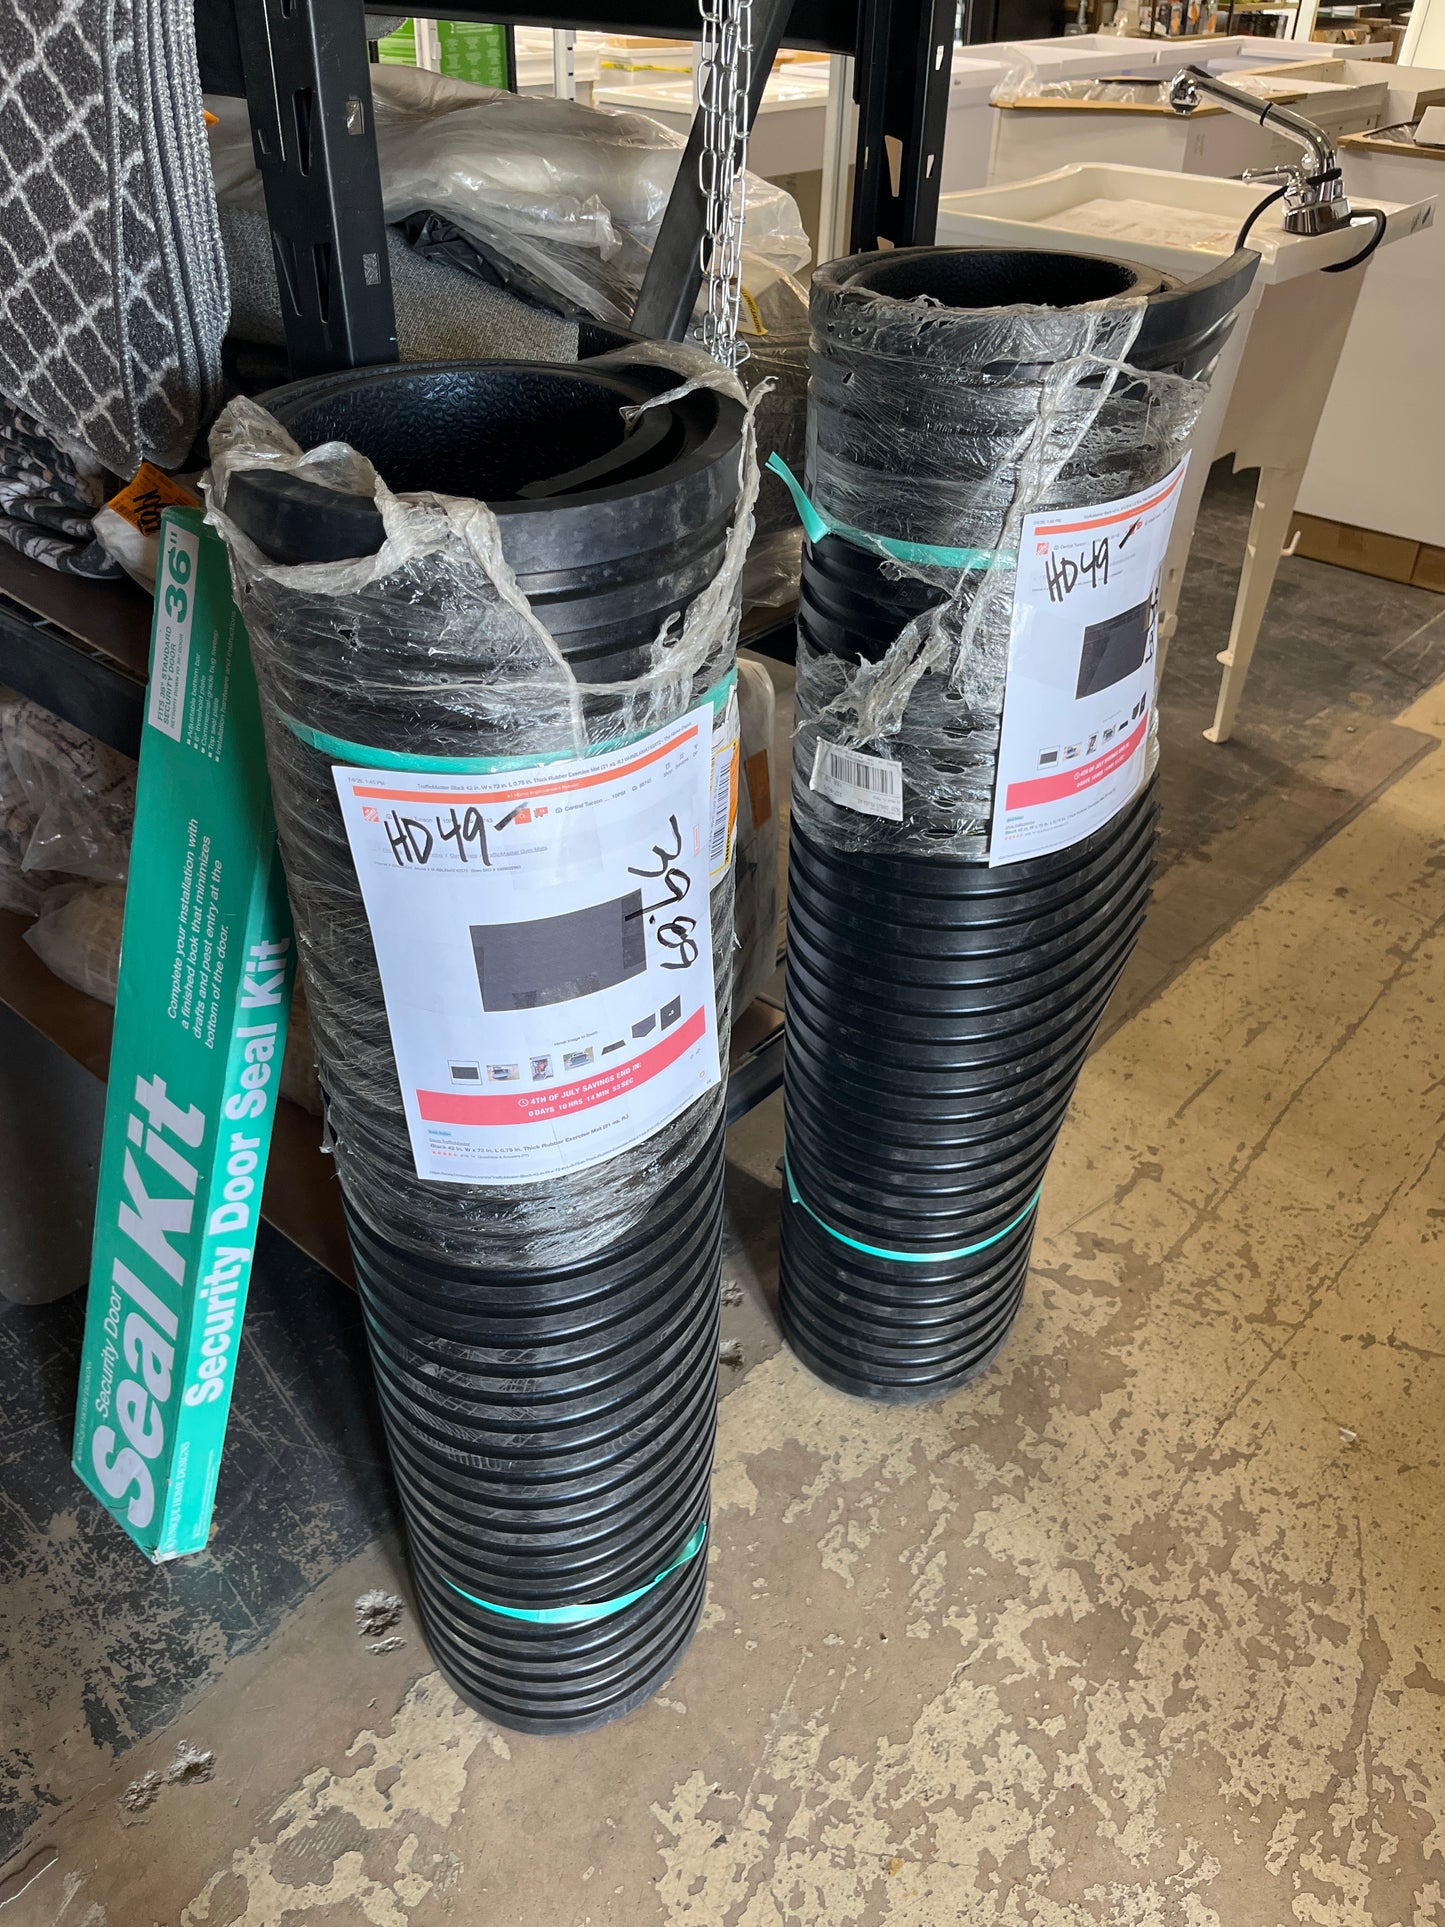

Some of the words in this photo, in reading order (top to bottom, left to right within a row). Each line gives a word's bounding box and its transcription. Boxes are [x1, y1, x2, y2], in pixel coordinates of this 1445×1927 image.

[165, 531, 192, 623] 36"
[158, 699, 166, 722] FITS
[162, 626, 172, 680] STANDARD
[164, 676, 173, 724] SECURITY
[169, 644, 177, 673] DOOR
[187, 698, 196, 738] Adjustable
[196, 699, 204, 732] threshold
[201, 675, 213, 746] Commercial-grade
[216, 708, 225, 754] Installation
[568, 769, 589, 777] Exercise
[565, 803, 584, 811] Central
[188, 818, 198, 847] with
[178, 851, 194, 924] installation
[196, 836, 210, 904] minimizes
[211, 860, 222, 883] the
[210, 884, 219, 900] at
[191, 905, 202, 933] that
[206, 902, 219, 938] entry
[176, 924, 187, 957] your
[187, 935, 199, 965] look
[202, 939, 212, 972] pest
[216, 924, 229, 959] door.
[168, 957, 183, 1019] Complete
[181, 965, 195, 1018] finished
[199, 971, 209, 999] and
[211, 983, 220, 1000] of
[213, 961, 224, 983] the
[240, 938, 290, 1008] Kit
[182, 1020, 189, 1030] a
[193, 1001, 205, 1039] drafts
[205, 1002, 219, 1050] bottom
[225, 1023, 278, 1120] Seal
[530, 1096, 546, 1105] 4TH
[549, 1094, 559, 1102] OF
[561, 1086, 580, 1099] JULY
[582, 1076, 614, 1092] SAVINGS
[617, 1068, 630, 1078] END
[632, 1062, 642, 1072] IN:
[535, 1106, 555, 1116] DAYS
[568, 1098, 583, 1108] HRS
[596, 1089, 609, 1099] MIN
[621, 1078, 634, 1088] SEC
[542, 1140, 563, 1148] Rubber
[565, 1132, 590, 1142] Exercise
[117, 1073, 206, 1287] Kit
[208, 1132, 261, 1237] Door
[104, 1286, 122, 1339] Door
[184, 1245, 251, 1408] Security
[92, 1257, 179, 1528] Seal
[95, 1338, 119, 1418] Security
